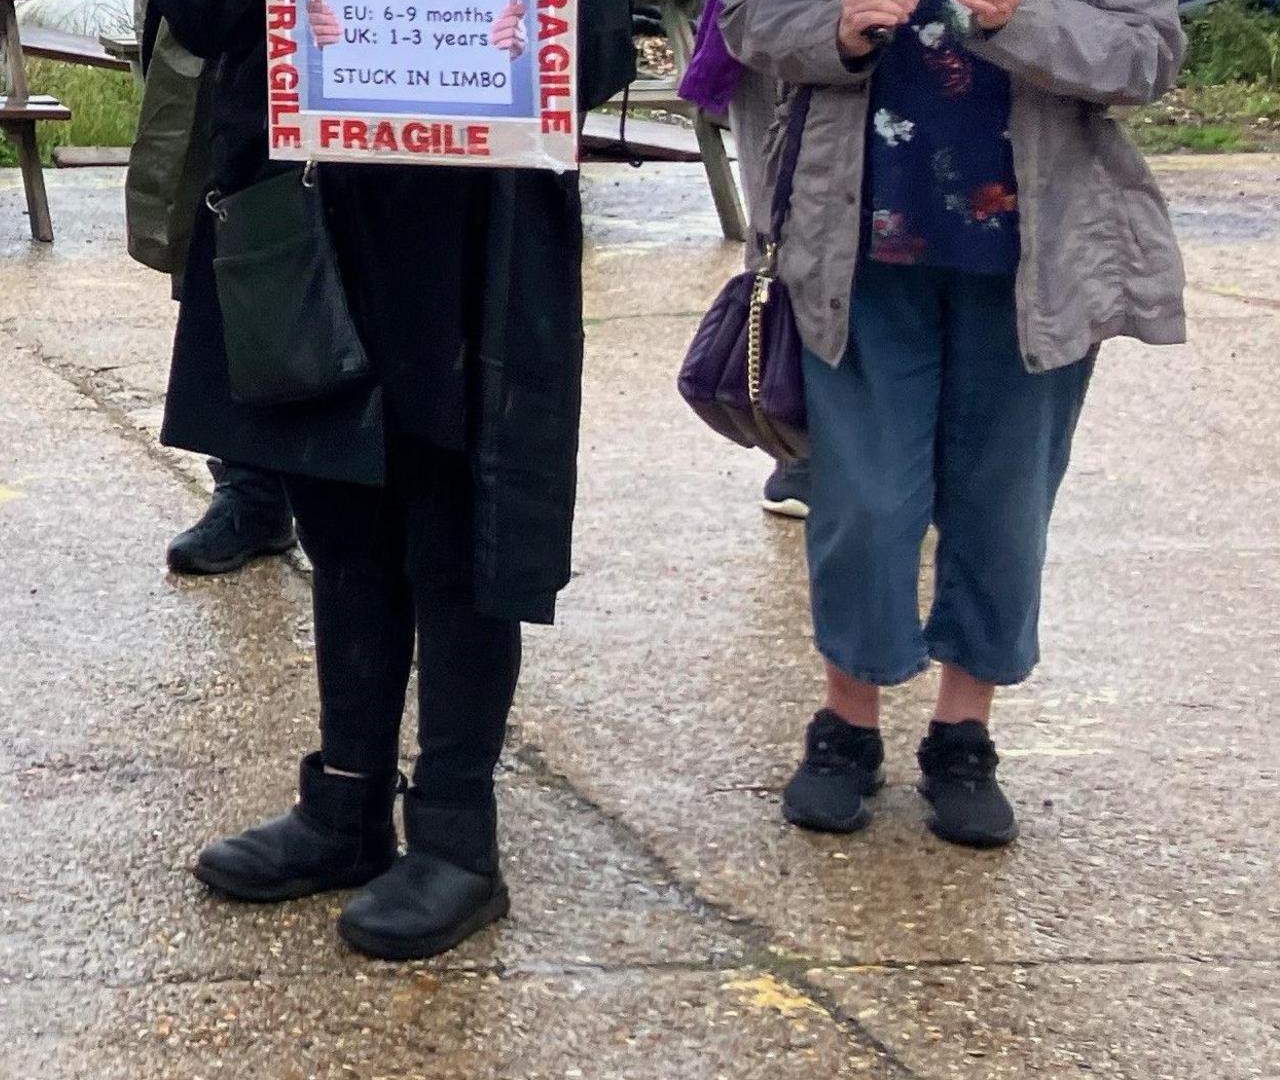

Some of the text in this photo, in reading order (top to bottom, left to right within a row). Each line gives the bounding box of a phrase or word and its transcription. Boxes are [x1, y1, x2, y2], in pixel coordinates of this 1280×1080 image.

[343, 5, 494, 23] EU: 6-9 months
[344, 29, 489, 51] UK: 1-3 years
[333, 69, 507, 88] STUCK IN LIMBO
[319, 120, 491, 156] FRAGILE
